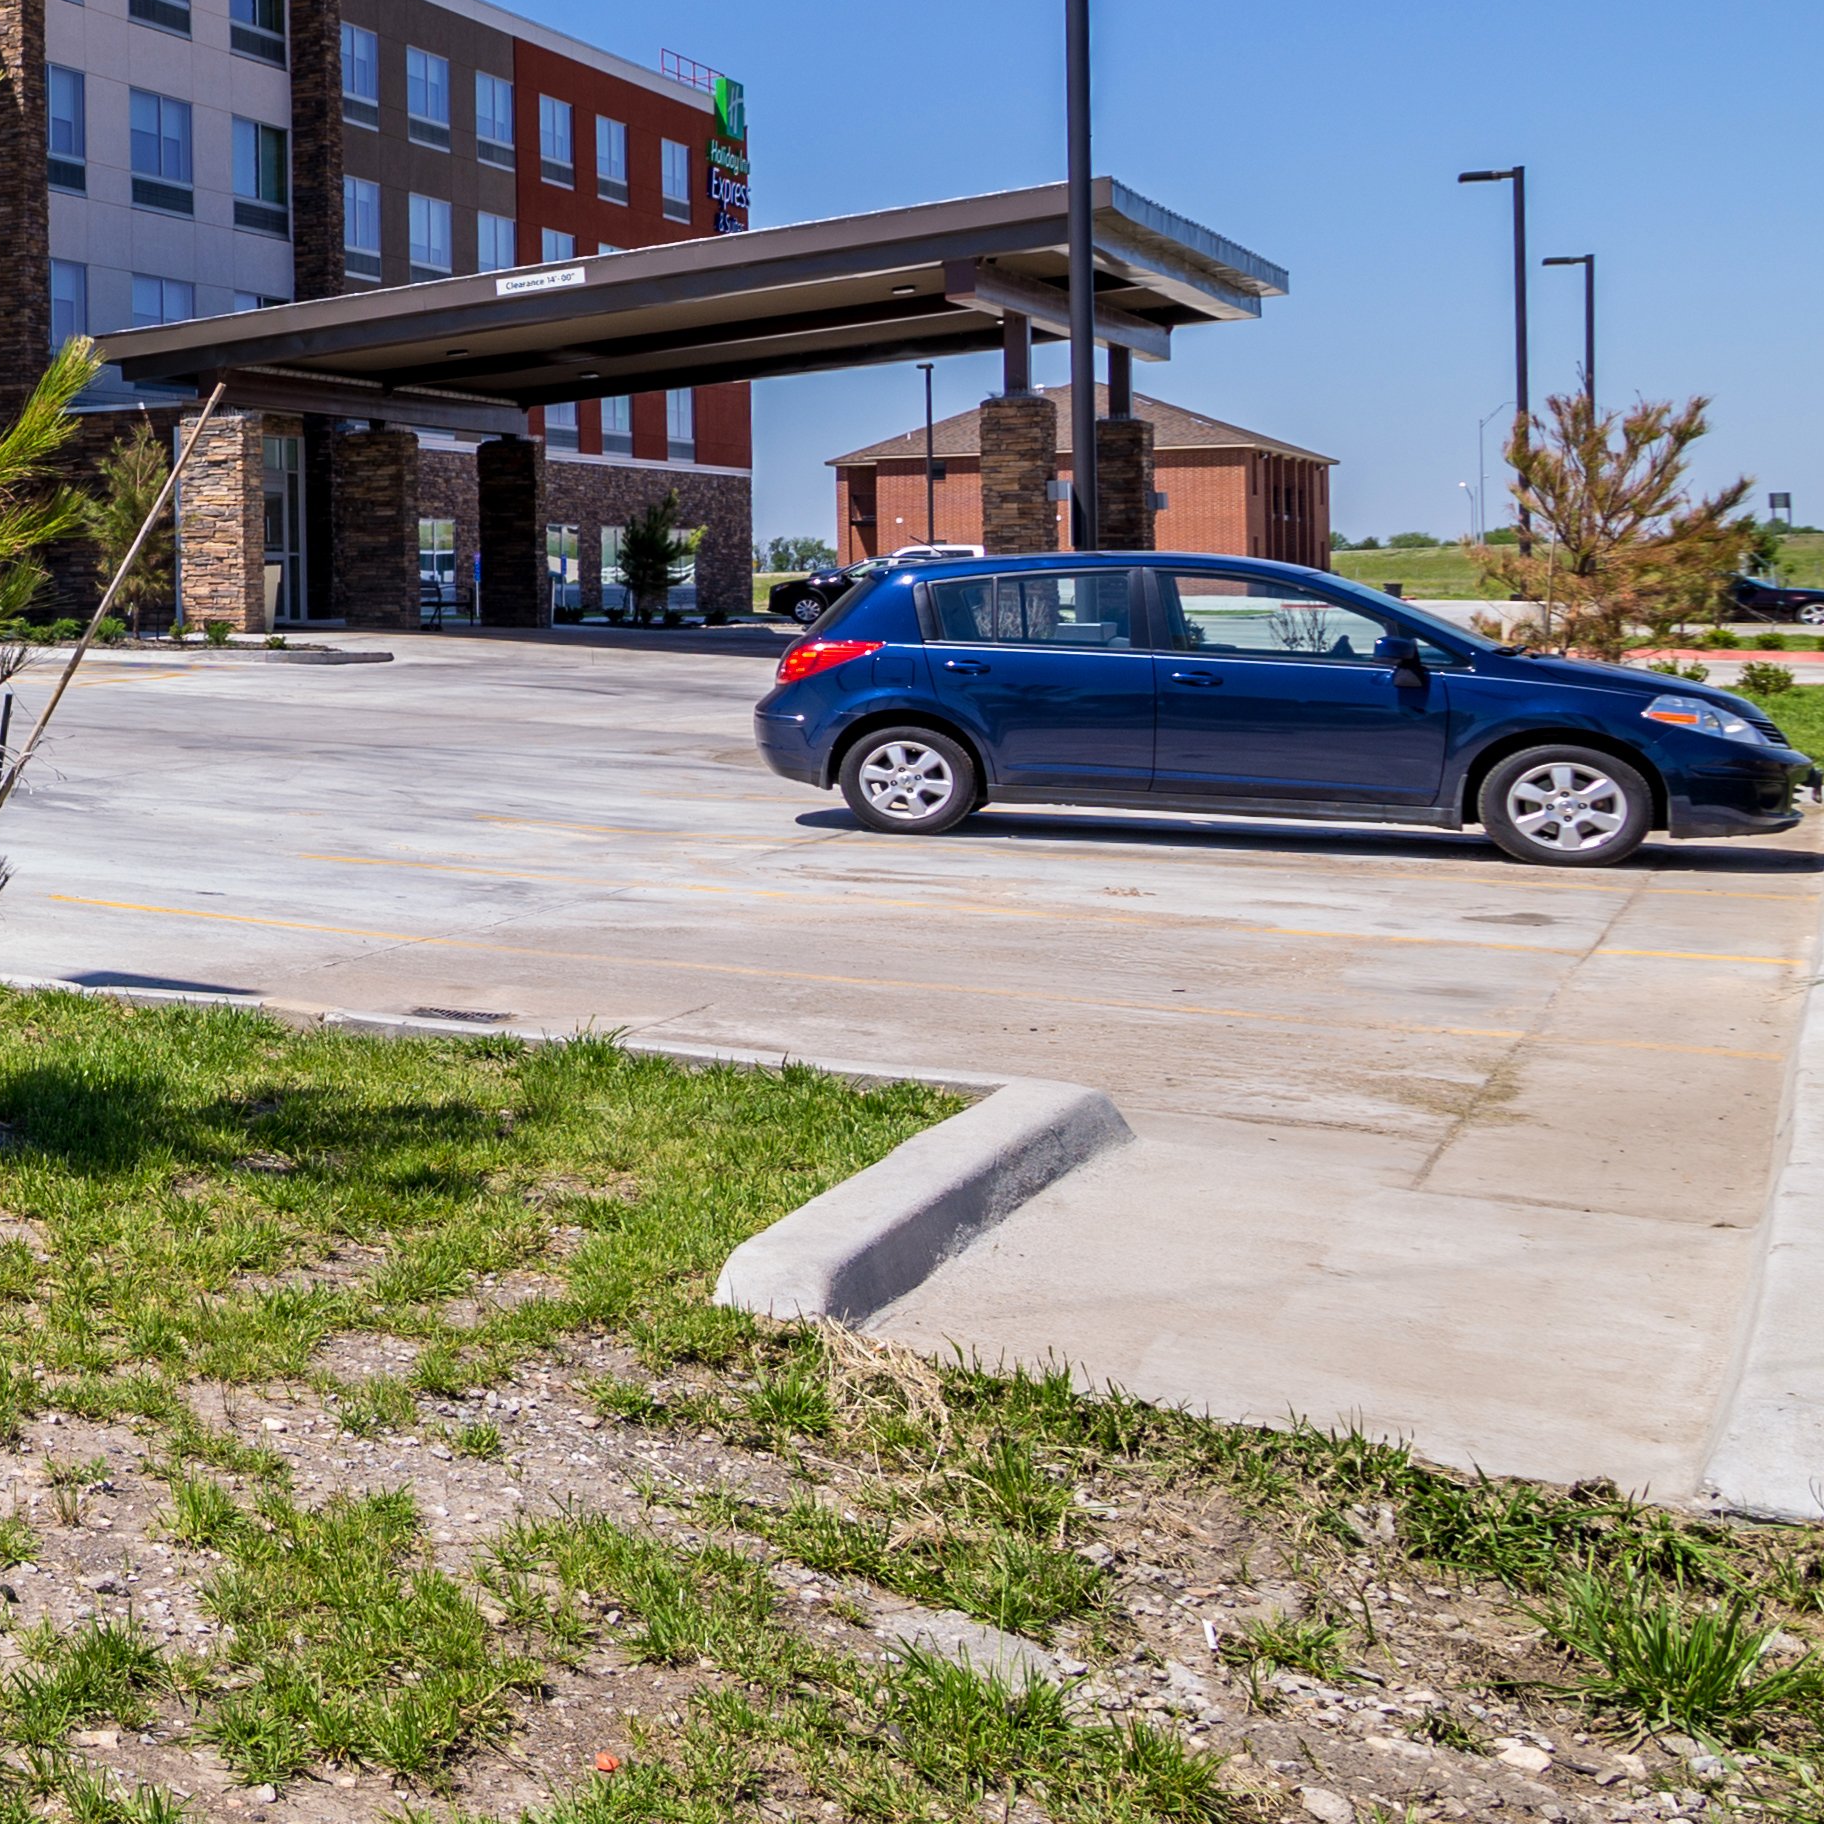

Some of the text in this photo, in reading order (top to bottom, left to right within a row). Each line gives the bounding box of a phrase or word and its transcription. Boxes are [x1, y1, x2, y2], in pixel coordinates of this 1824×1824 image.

[711, 139, 740, 176] Holiday
[712, 167, 751, 209] Express
[506, 279, 544, 290] Clearance
